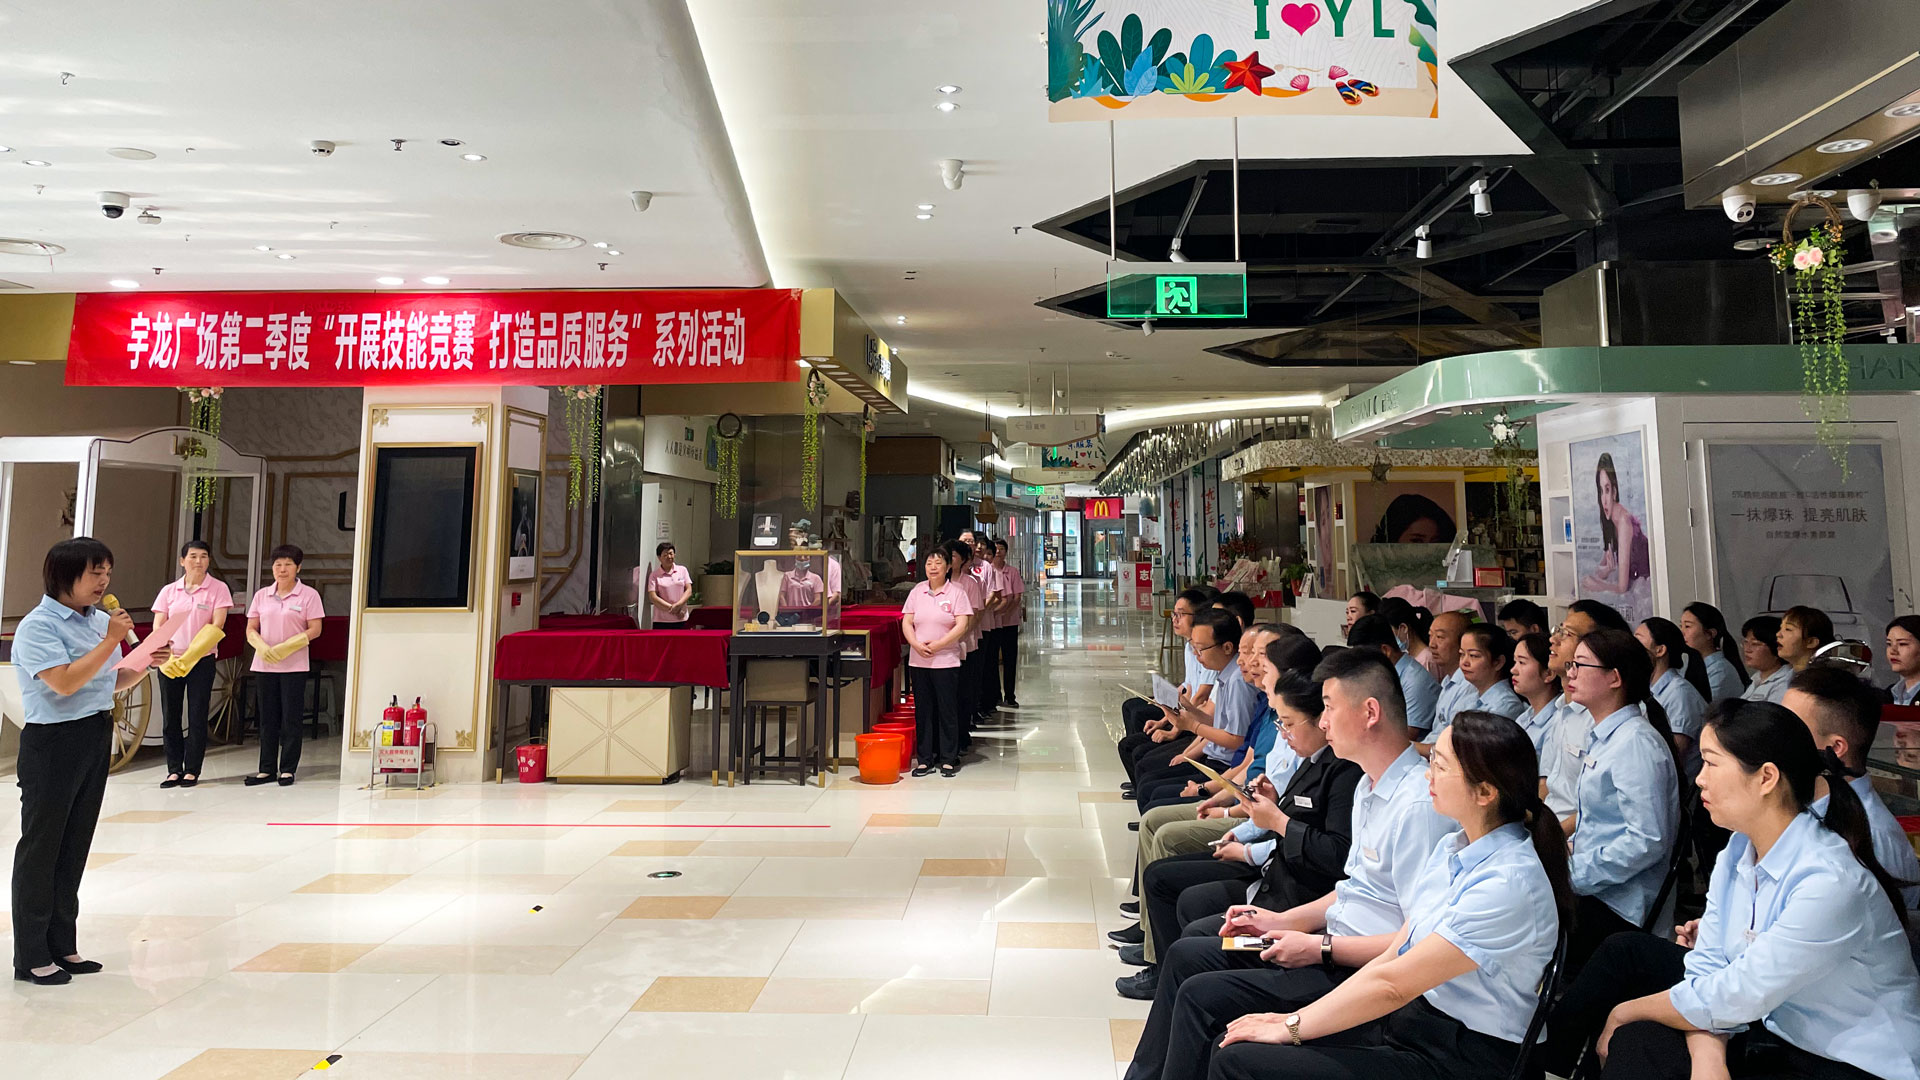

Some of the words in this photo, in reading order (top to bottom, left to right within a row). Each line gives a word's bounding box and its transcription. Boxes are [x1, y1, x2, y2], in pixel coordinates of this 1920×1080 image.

[1253, 0, 1270, 40] I
[1730, 507, 1795, 523] 一抹爆珠
[1803, 507, 1868, 523] 提亮肌肤
